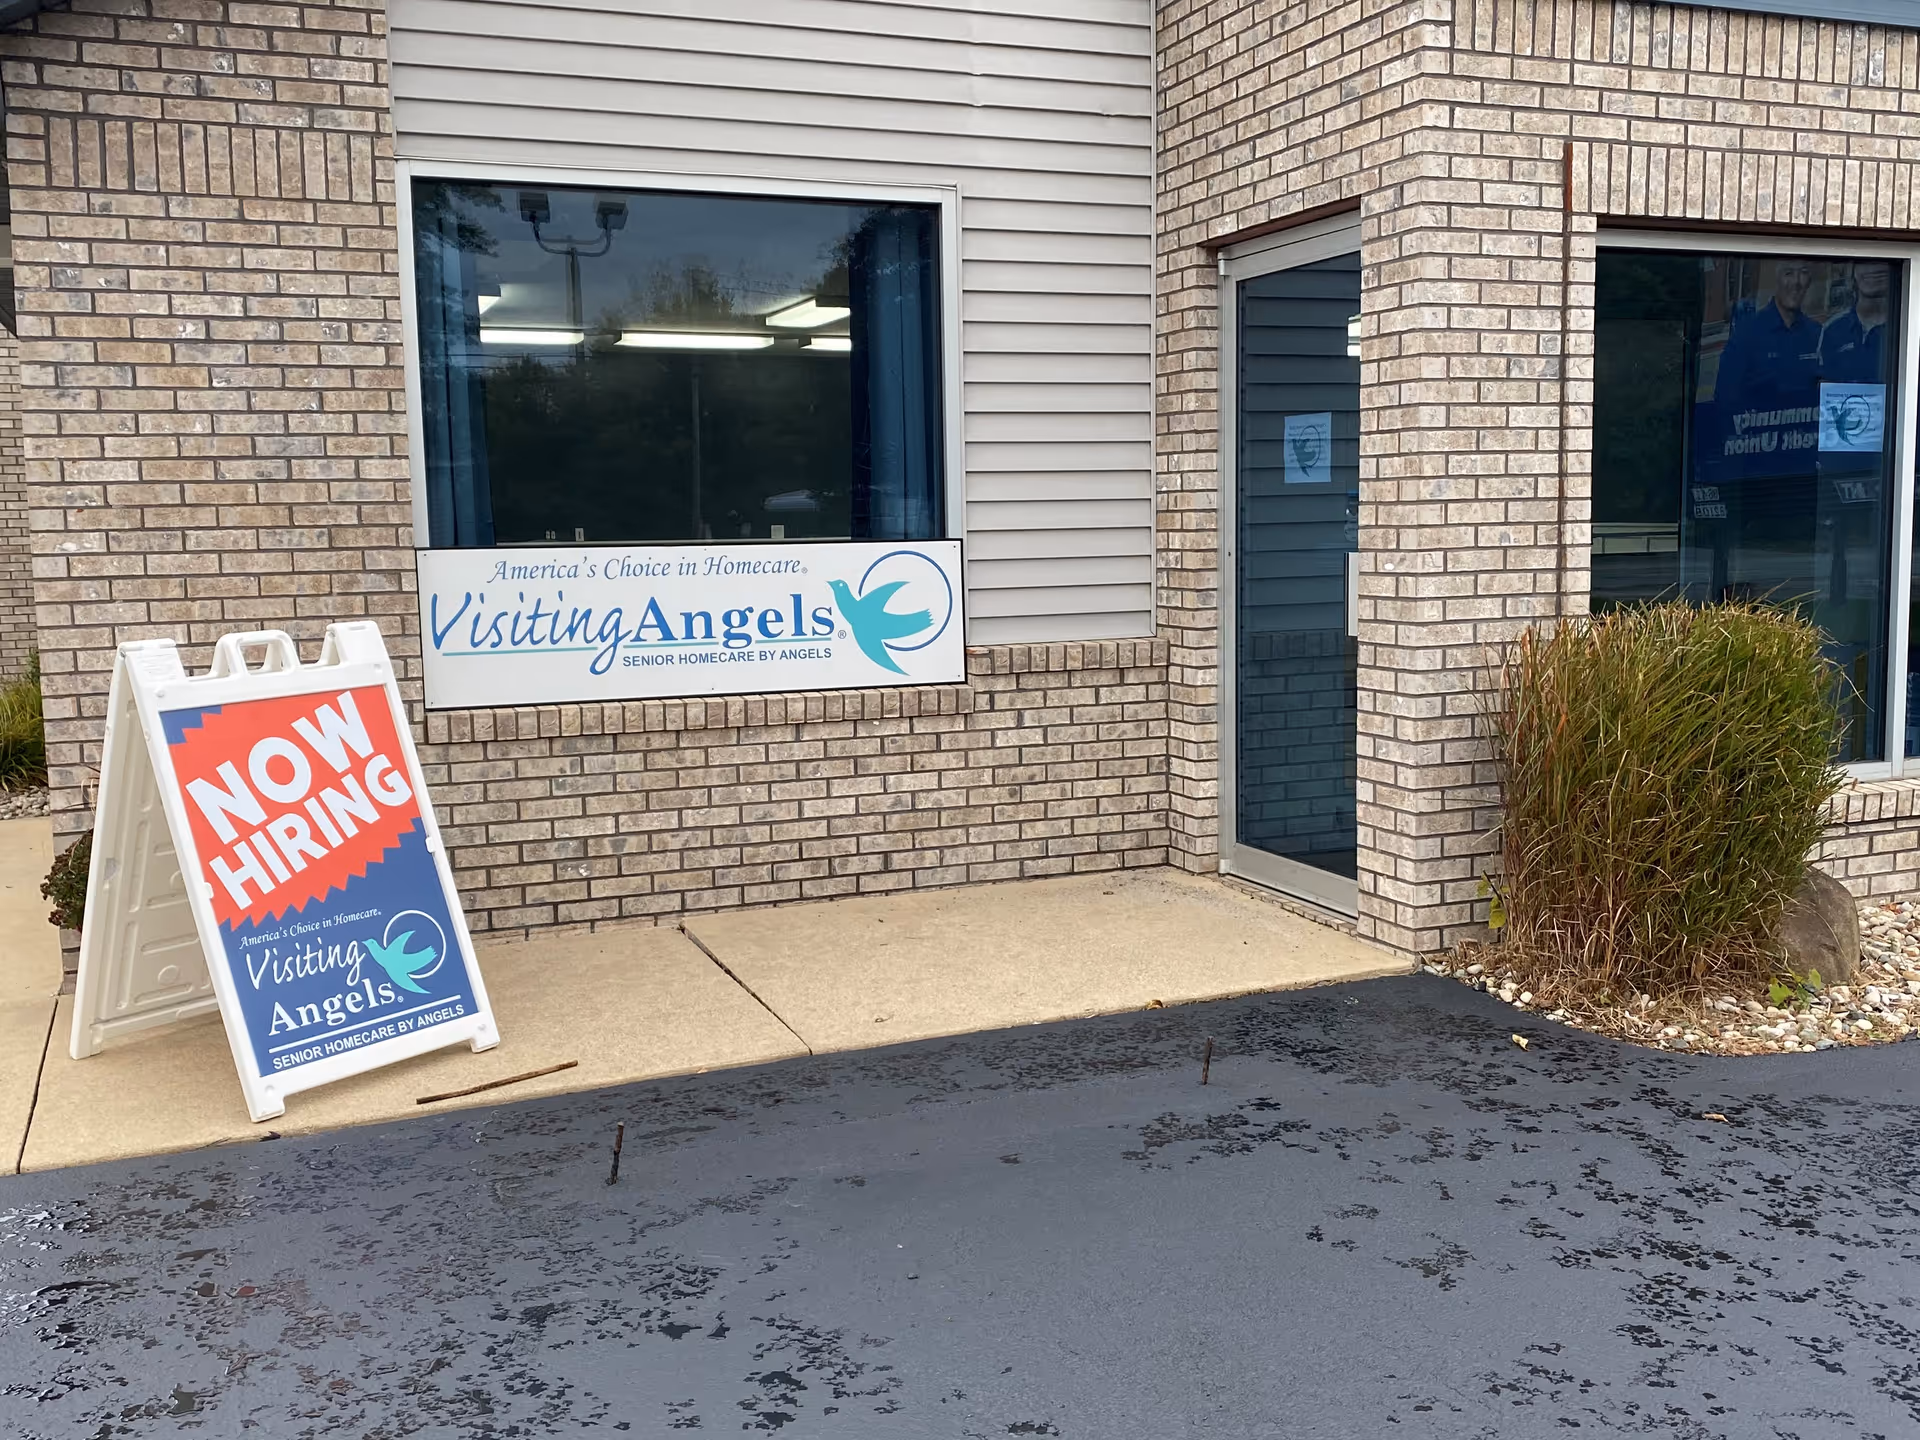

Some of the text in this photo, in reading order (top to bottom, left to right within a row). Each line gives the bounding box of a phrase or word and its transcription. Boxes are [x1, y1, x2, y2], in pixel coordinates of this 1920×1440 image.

[486, 554, 801, 584] America's Choice in Homecare
[431, 590, 835, 676] Visiting Angels
[622, 647, 832, 667] SENIOR HOMECARE BY ANGELS
[185, 690, 374, 845] NOW
[208, 753, 413, 910] HIRING
[238, 907, 379, 950] America's Choice in Homecare
[245, 936, 366, 991] Visiting
[268, 978, 396, 1037] Angels
[272, 1004, 465, 1070] SENIOR HOMECARE BY ANGELS
